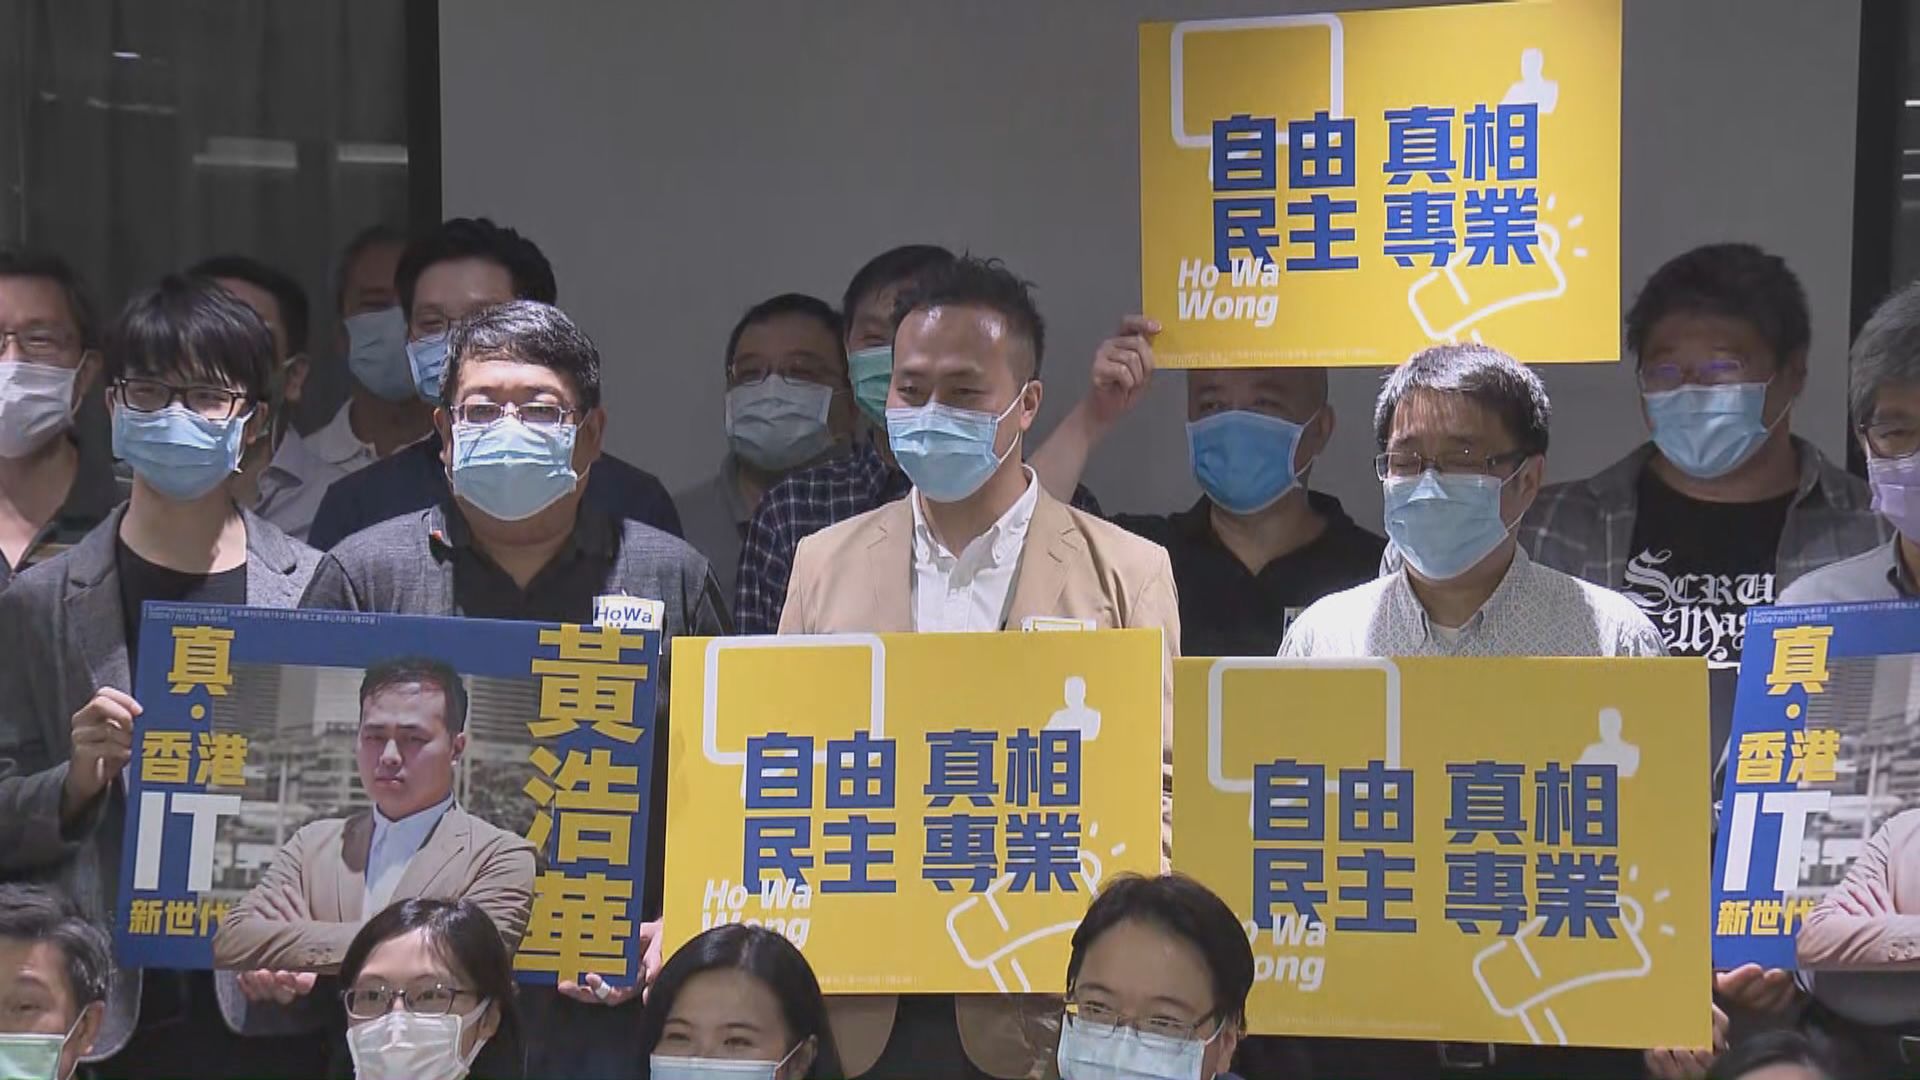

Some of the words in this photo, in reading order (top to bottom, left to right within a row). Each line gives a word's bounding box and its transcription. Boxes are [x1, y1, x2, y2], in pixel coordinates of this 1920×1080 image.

[1212, 110, 1356, 191] 自由
[1382, 102, 1538, 185] 真相
[1212, 194, 1358, 272] 民主
[1382, 187, 1539, 267] 專業
[1178, 258, 1219, 289] Ho
[1230, 257, 1279, 288] Wa
[1177, 288, 1278, 327] Wong
[594, 606, 652, 623] HoWa
[140, 730, 249, 786] 香港
[744, 730, 897, 811] 自由
[922, 728, 1082, 808] 真相
[1735, 728, 1840, 784] 香港
[512, 624, 649, 985] 黃浩華
[1253, 759, 1414, 843] 自由
[1444, 760, 1618, 847] 真相
[133, 791, 241, 893] IT
[742, 814, 897, 896] 民主
[921, 812, 1082, 894] 專業
[1722, 791, 1831, 893] IT
[128, 899, 231, 937] 新世代
[703, 879, 748, 912] Ho
[759, 878, 812, 910] Wa
[1252, 848, 1417, 934] 民主
[1444, 851, 1620, 938] 專業
[1716, 899, 1815, 937] 新世代
[1271, 914, 1327, 946] Wa
[1254, 954, 1325, 991] ong
